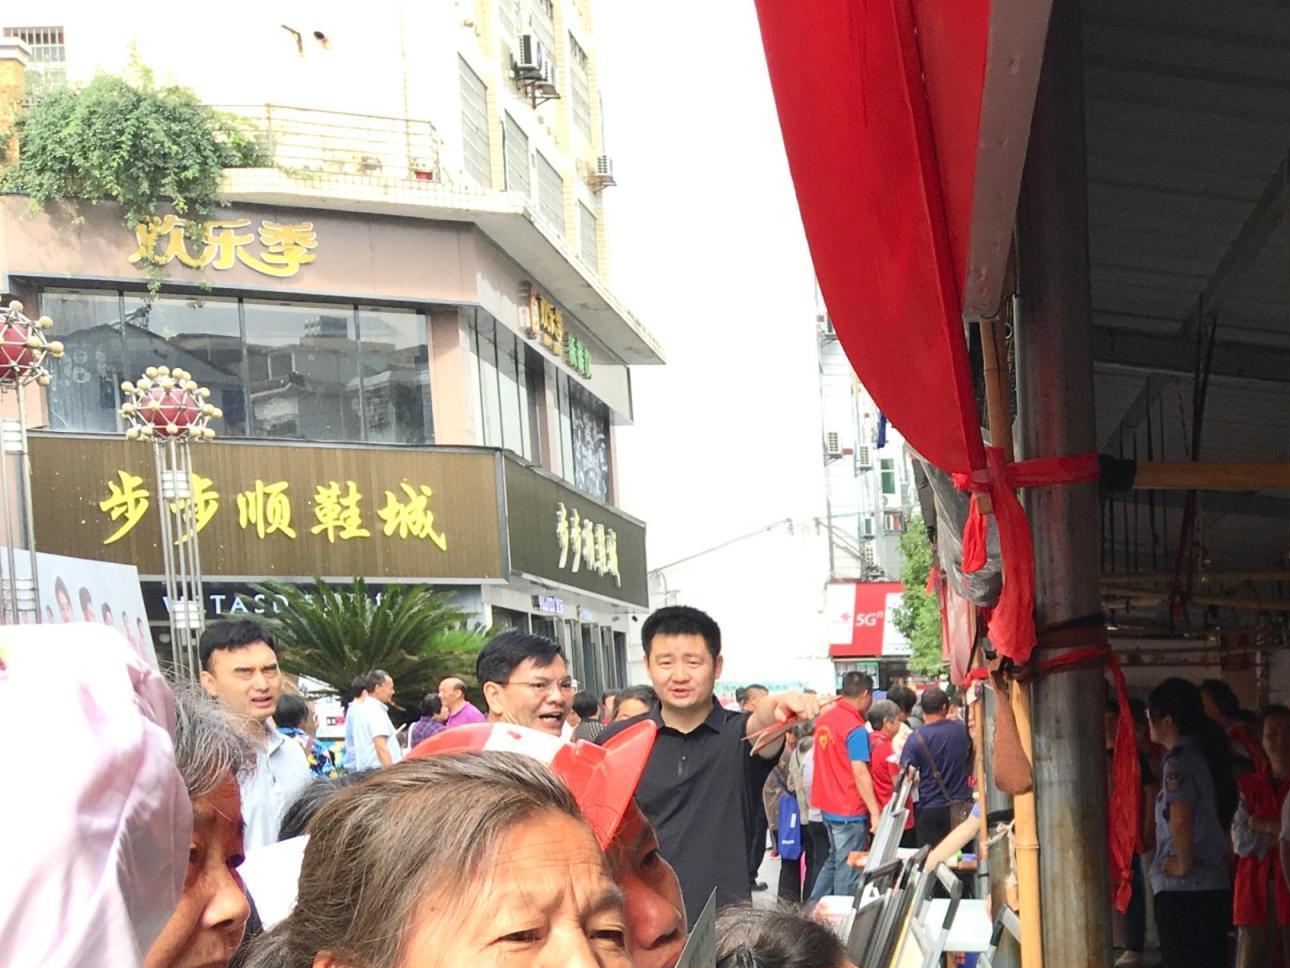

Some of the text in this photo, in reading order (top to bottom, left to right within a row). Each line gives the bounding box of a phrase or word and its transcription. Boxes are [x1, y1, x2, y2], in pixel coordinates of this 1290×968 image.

[99, 470, 446, 551] 步步顺鞋城
